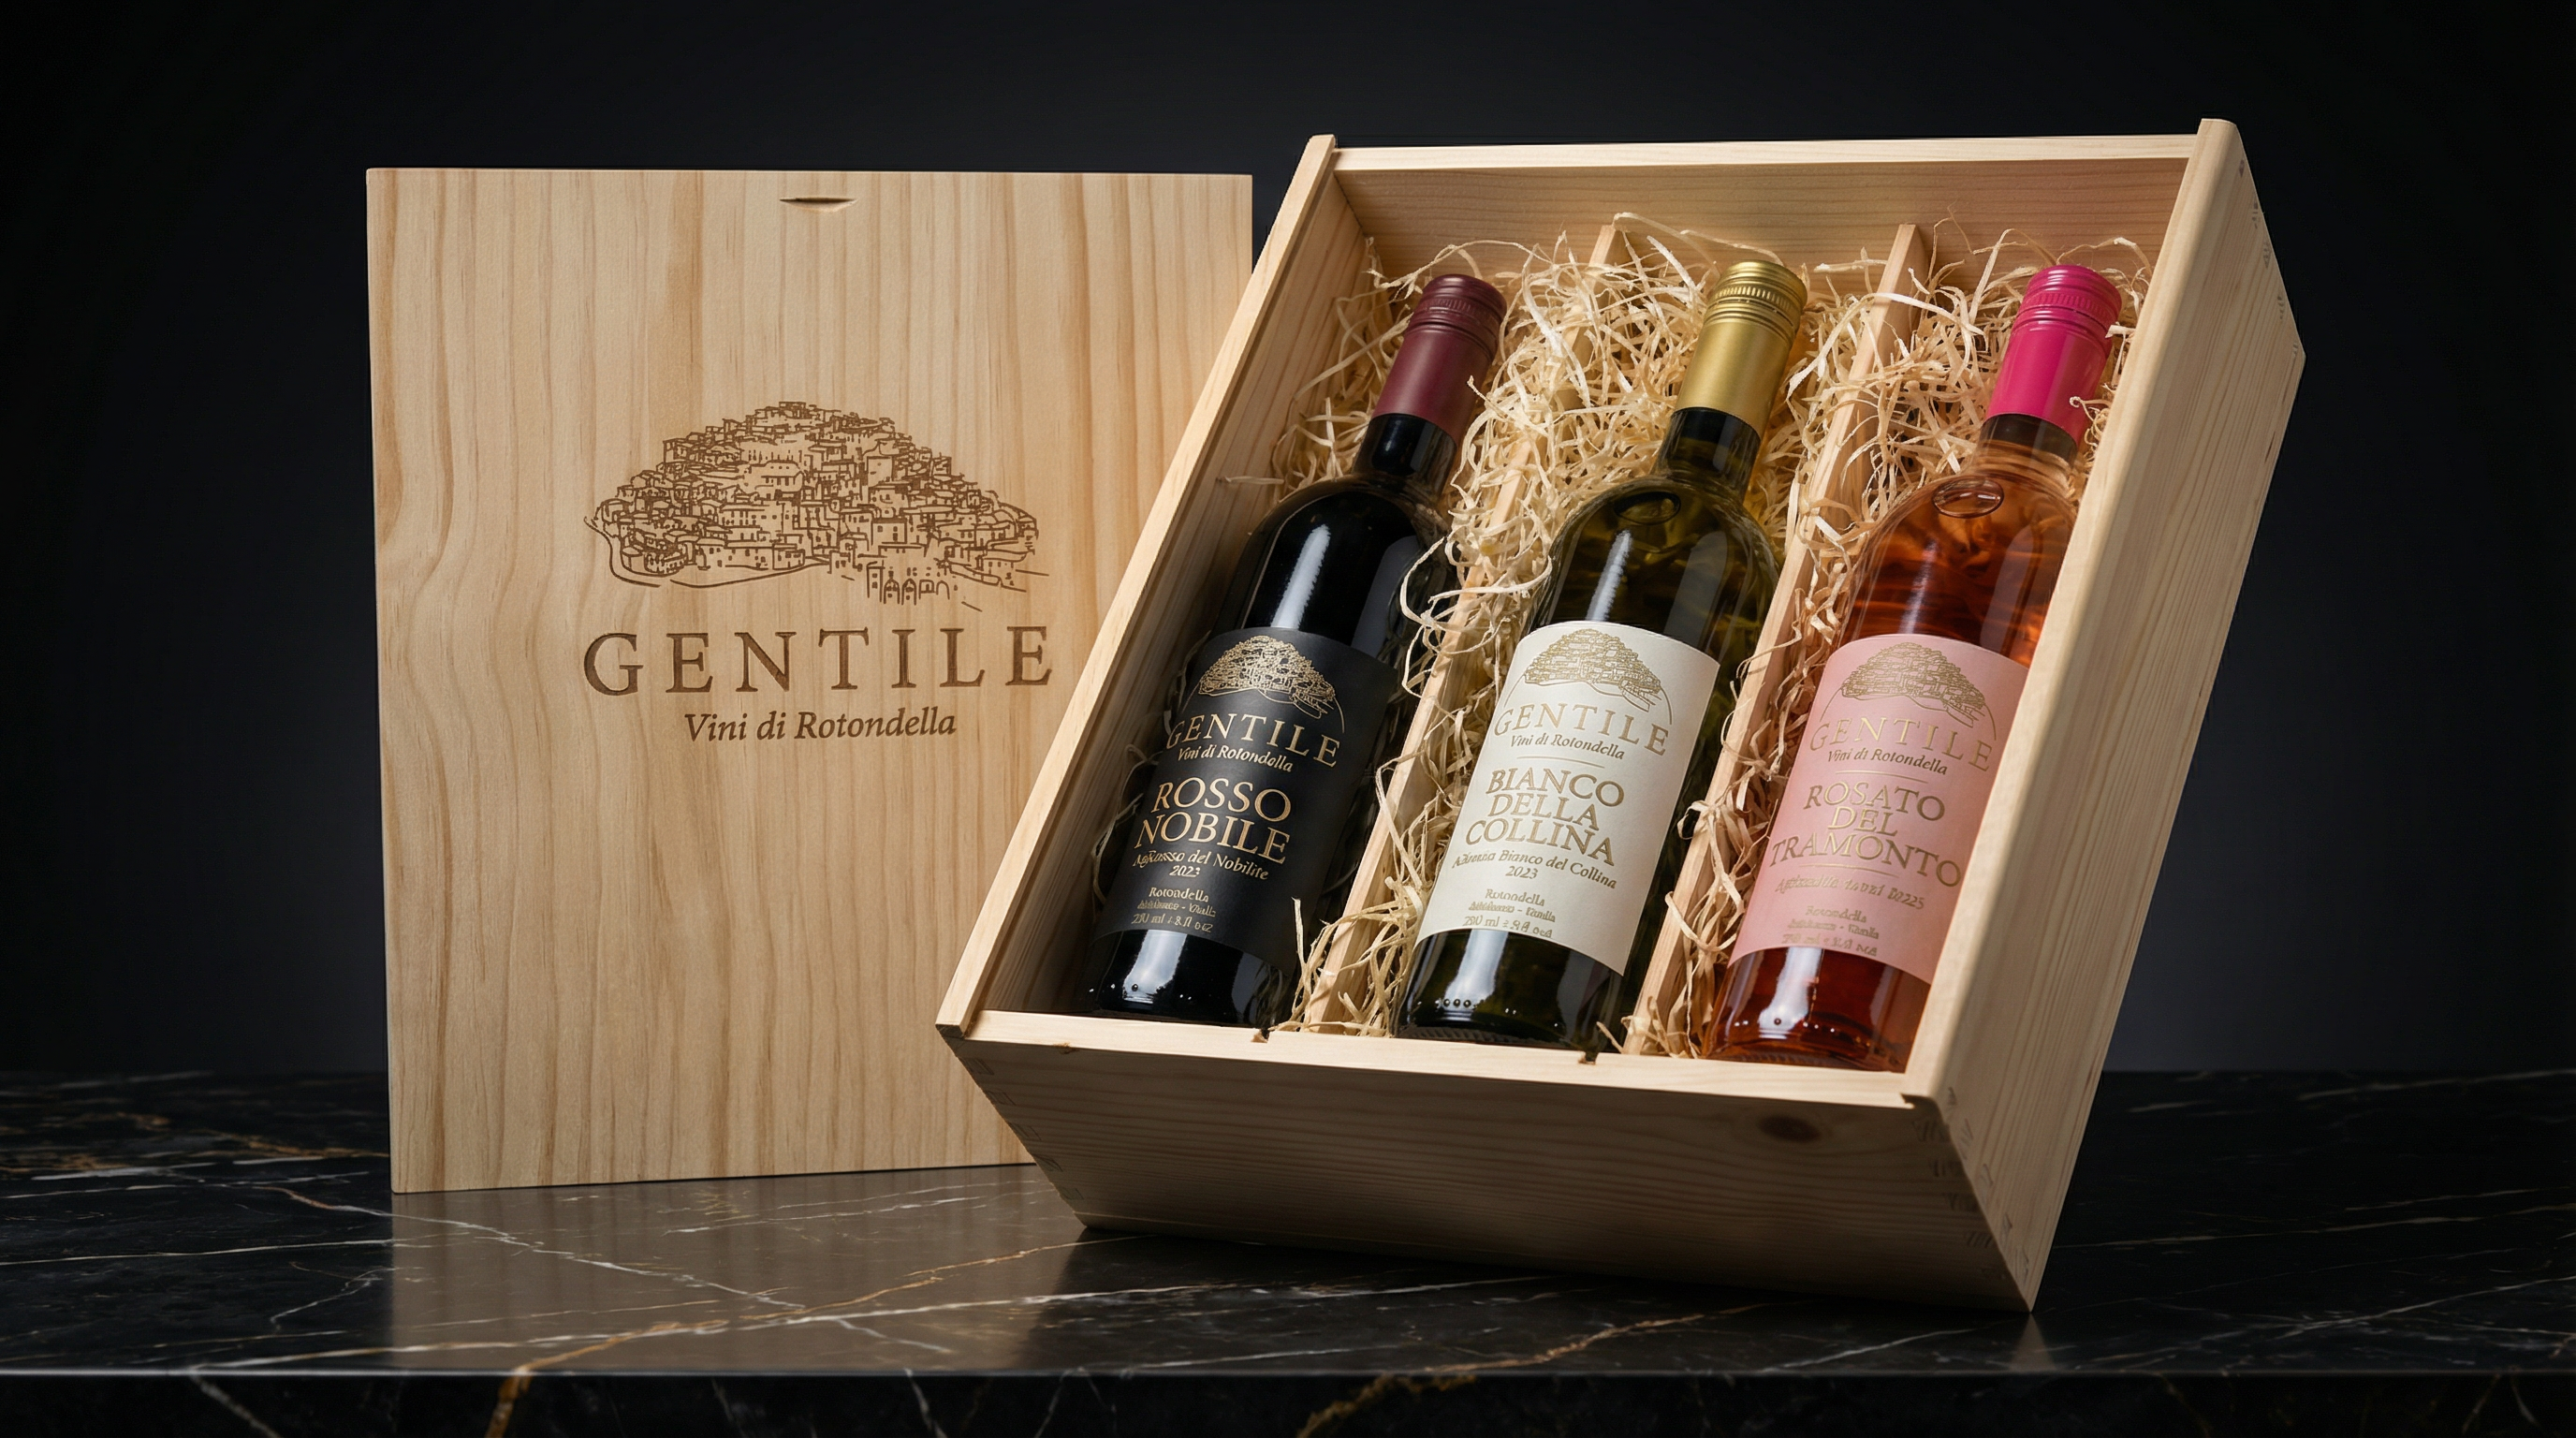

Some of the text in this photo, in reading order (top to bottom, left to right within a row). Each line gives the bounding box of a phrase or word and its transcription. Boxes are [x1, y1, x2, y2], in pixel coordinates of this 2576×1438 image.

[584, 625, 1053, 697] GENTILE
[684, 705, 958, 742] Vini di Rotondella
[1165, 712, 1341, 768] GENTILE
[1493, 701, 1670, 756] GENTILE
[1534, 731, 1548, 746] di
[1809, 716, 1994, 772] GENTILE
[1200, 743, 1218, 759] di
[1870, 748, 1949, 776] Rotondella
[1150, 776, 1292, 822] ROSSO
[1485, 767, 1625, 808] BIANCO
[1803, 781, 1946, 822] ROSATO
[1486, 791, 1600, 831] DELLA
[1827, 805, 1898, 837] DEL
[1134, 810, 1291, 865] NOBILE
[1187, 849, 1212, 865] del
[1465, 817, 1616, 867] COLLINA
[1497, 849, 1544, 866] Bianco
[1544, 856, 1570, 872] del
[1569, 861, 1618, 889] Collina
[1505, 865, 1539, 880] 2023
[1769, 831, 1962, 888] TRAMONTO
